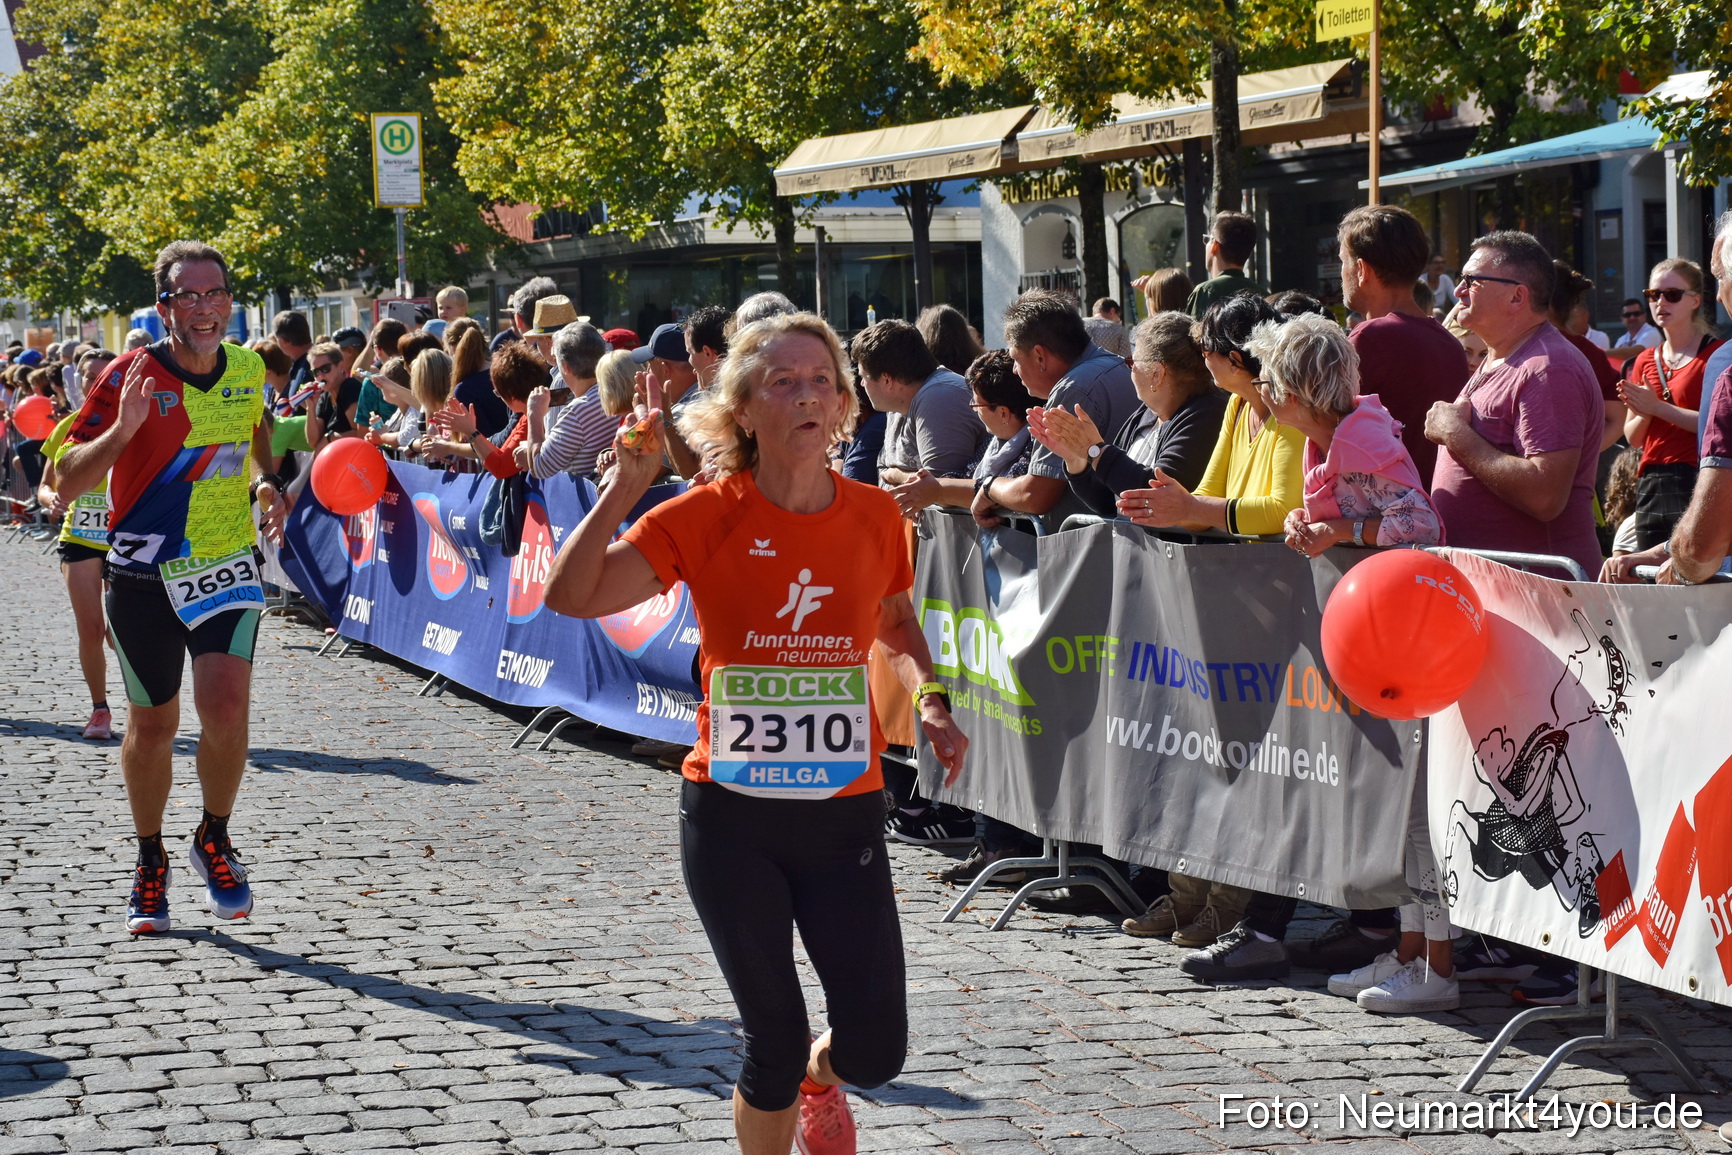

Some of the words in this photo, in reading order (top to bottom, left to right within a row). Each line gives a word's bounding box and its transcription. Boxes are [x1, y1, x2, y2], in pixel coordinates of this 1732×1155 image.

[1326, 7, 1371, 28] Toiletten
[80, 495, 107, 507] BO
[749, 548, 776, 557] erima
[177, 560, 254, 603] 2693
[200, 585, 257, 612] CLAUS
[743, 631, 853, 650] funrunners
[776, 649, 863, 664] neumarkt
[1127, 641, 1281, 704] INDUSTRY
[636, 682, 658, 716] GET
[724, 673, 854, 701] BOCK
[729, 713, 853, 753] 2310
[750, 767, 829, 784] HELGA
